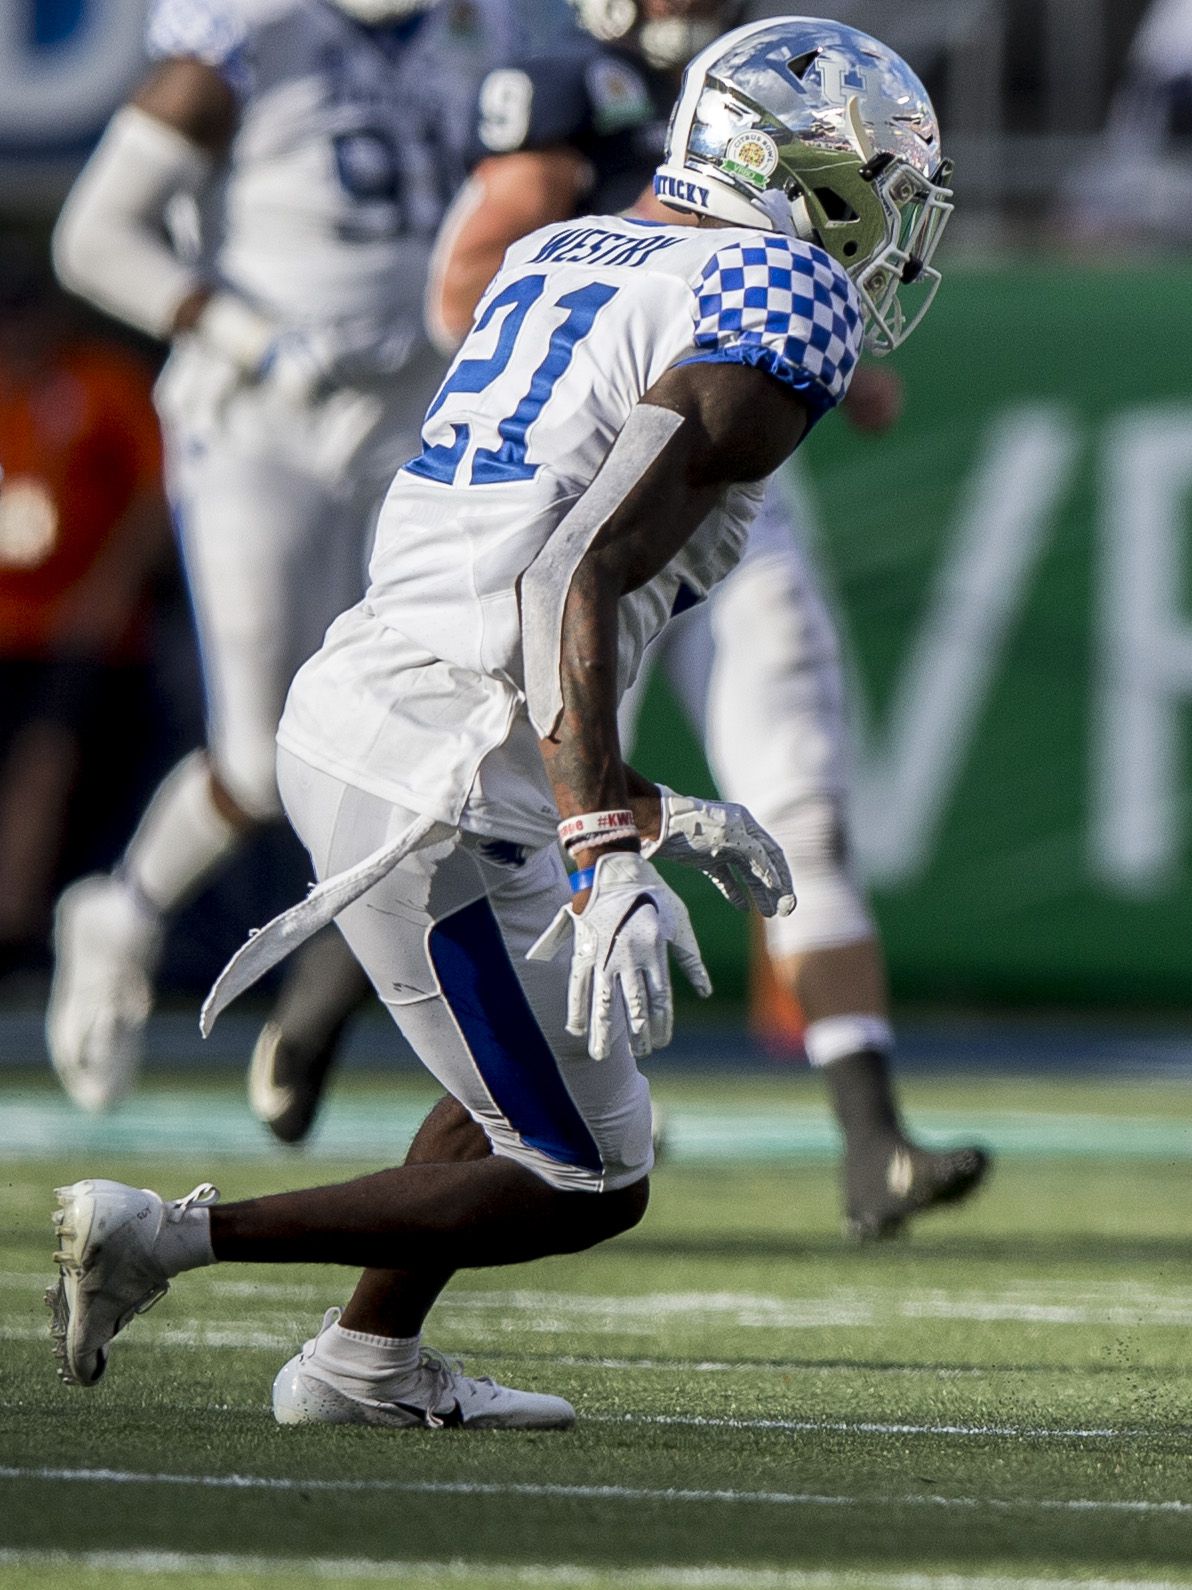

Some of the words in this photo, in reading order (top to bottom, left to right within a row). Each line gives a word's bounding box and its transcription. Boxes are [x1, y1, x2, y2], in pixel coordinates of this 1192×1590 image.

[478, 67, 534, 152] 9
[525, 228, 689, 268] WESTRY
[402, 274, 620, 486] 21
